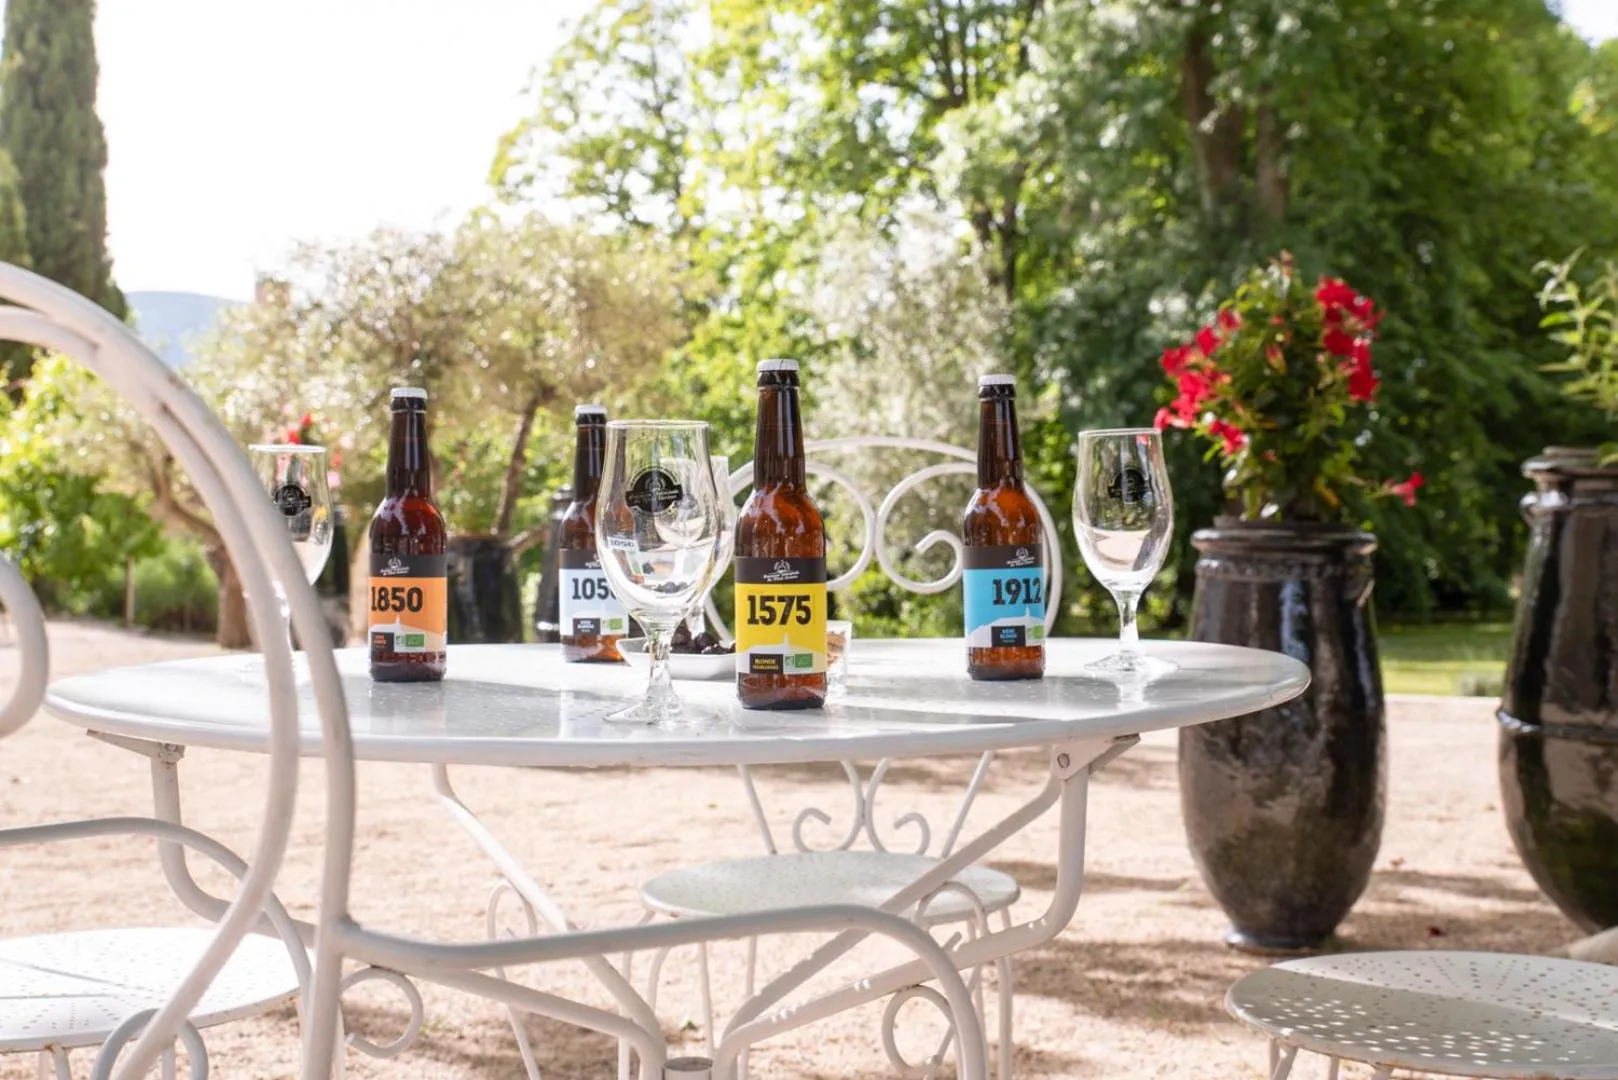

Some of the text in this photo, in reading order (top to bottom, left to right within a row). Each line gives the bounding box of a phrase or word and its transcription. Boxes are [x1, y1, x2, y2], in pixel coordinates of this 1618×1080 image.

[371, 586, 423, 612] 1850
[572, 578, 617, 600] 105
[992, 577, 1042, 605] 1912
[747, 595, 811, 626] 1575
